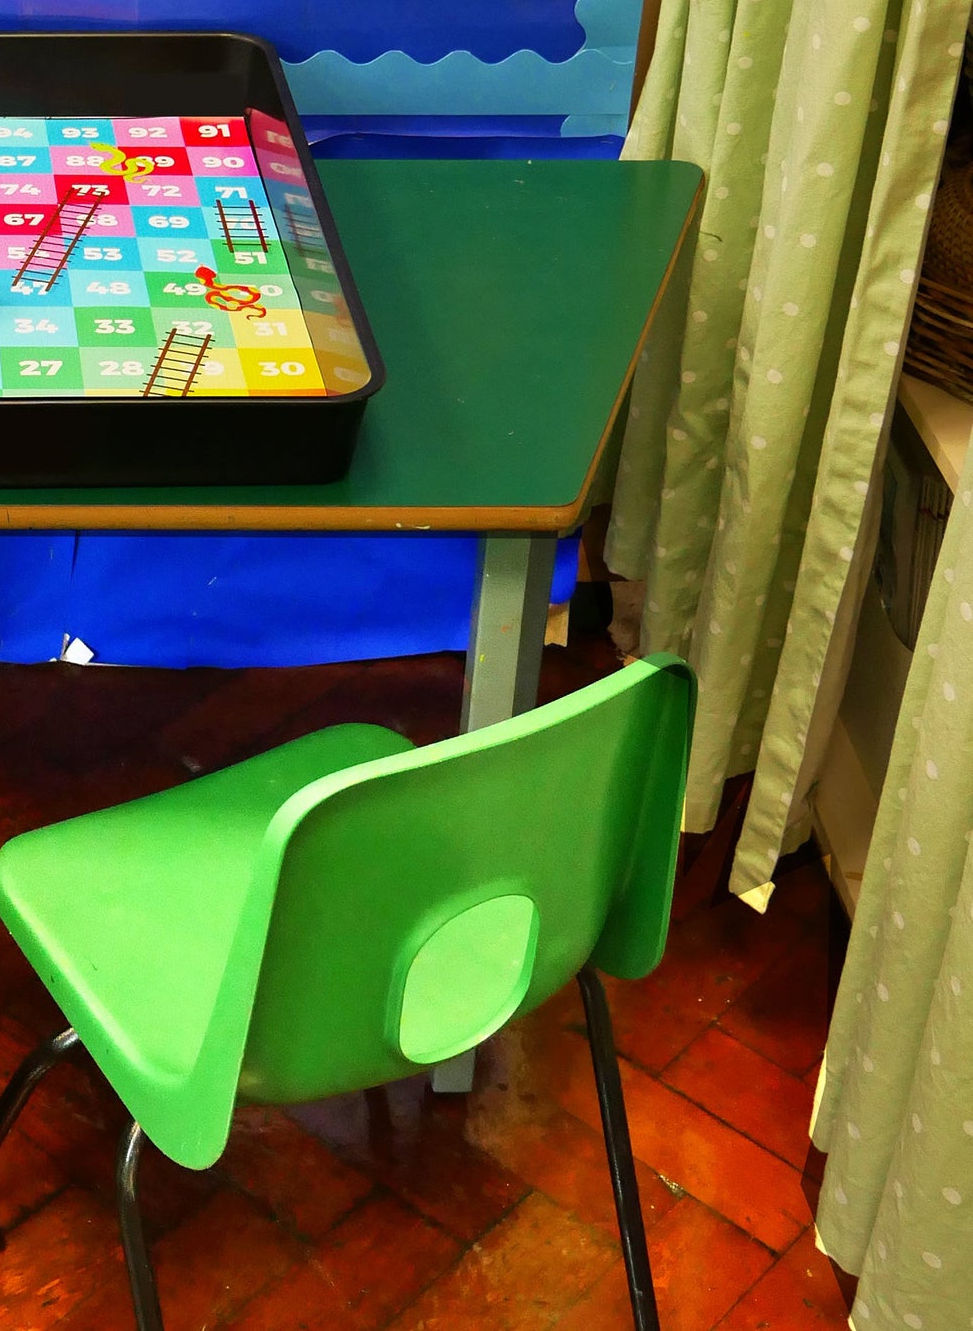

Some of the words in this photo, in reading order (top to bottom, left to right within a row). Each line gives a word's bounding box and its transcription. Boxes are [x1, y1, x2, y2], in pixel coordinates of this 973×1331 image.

[61, 127, 100, 139] 93
[128, 127, 168, 139] 92
[198, 124, 231, 138] 91
[65, 155, 105, 167] 88
[202, 156, 245, 169] 90
[0, 183, 41, 196] 74
[71, 184, 111, 197] 73
[141, 185, 182, 197] 72
[215, 186, 248, 199] 71
[3, 213, 45, 226] 67
[148, 215, 190, 229] 69
[83, 247, 123, 261] 53
[156, 249, 198, 263] 52
[234, 251, 268, 265] 51
[10, 282, 50, 296] 47
[86, 281, 131, 295] 48
[163, 282, 208, 296] 49
[14, 318, 59, 334] 34
[93, 319, 136, 334] 33
[171, 321, 215, 336] 32
[254, 321, 288, 337] 31
[19, 360, 63, 376] 27
[99, 360, 144, 376] 28
[258, 361, 306, 377] 30
